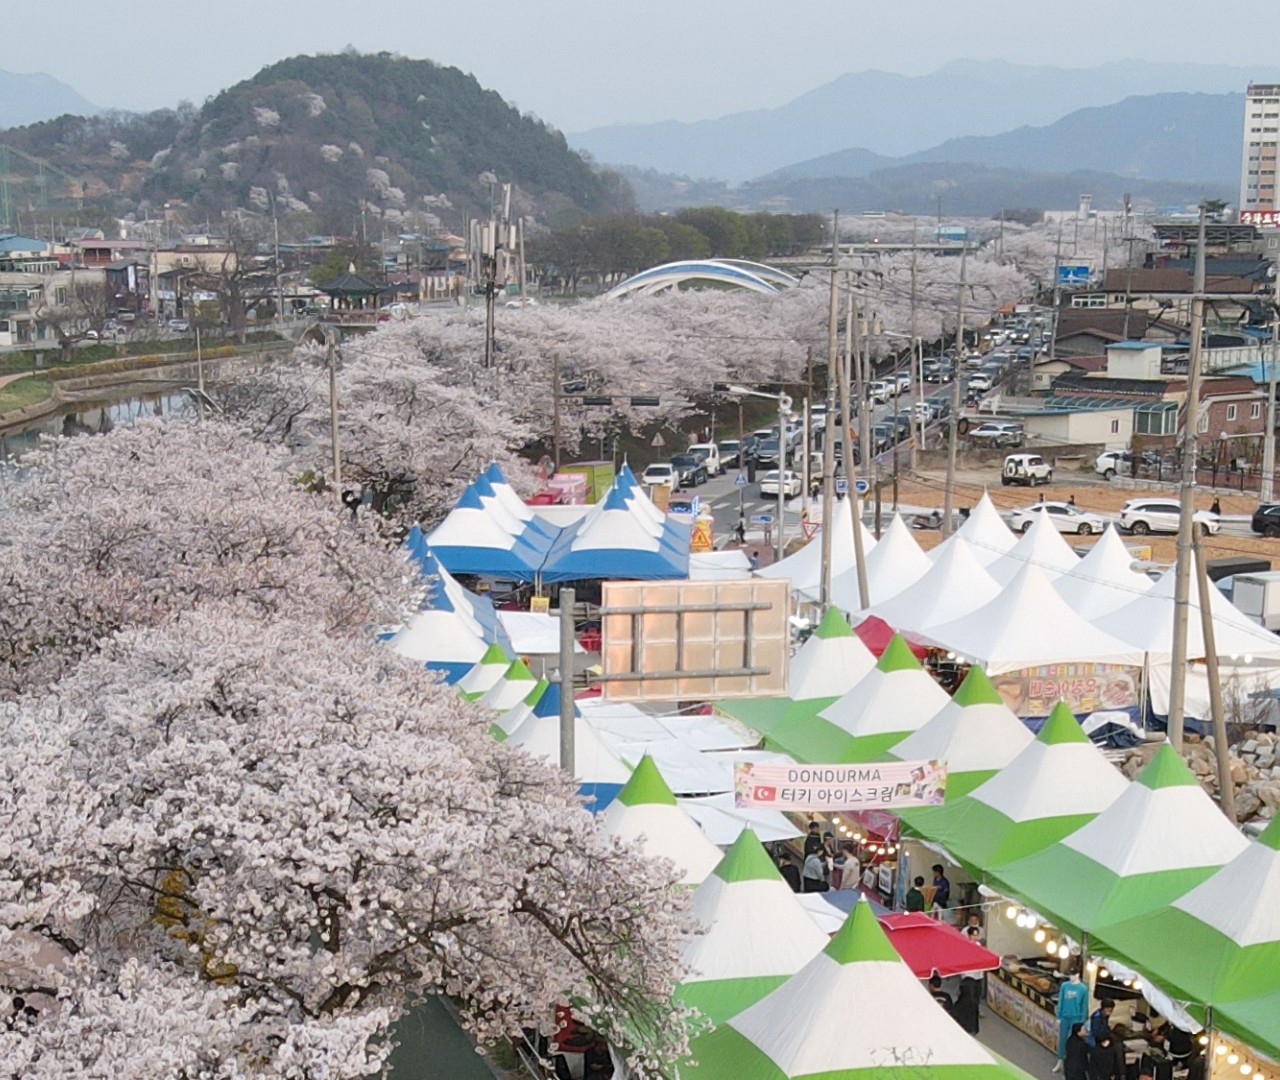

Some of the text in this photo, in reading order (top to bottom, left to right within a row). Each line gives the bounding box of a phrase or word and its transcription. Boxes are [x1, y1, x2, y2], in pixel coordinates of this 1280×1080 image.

[788, 769, 882, 783] DONDURMA
[781, 787, 893, 804] 터키 아이스크림
